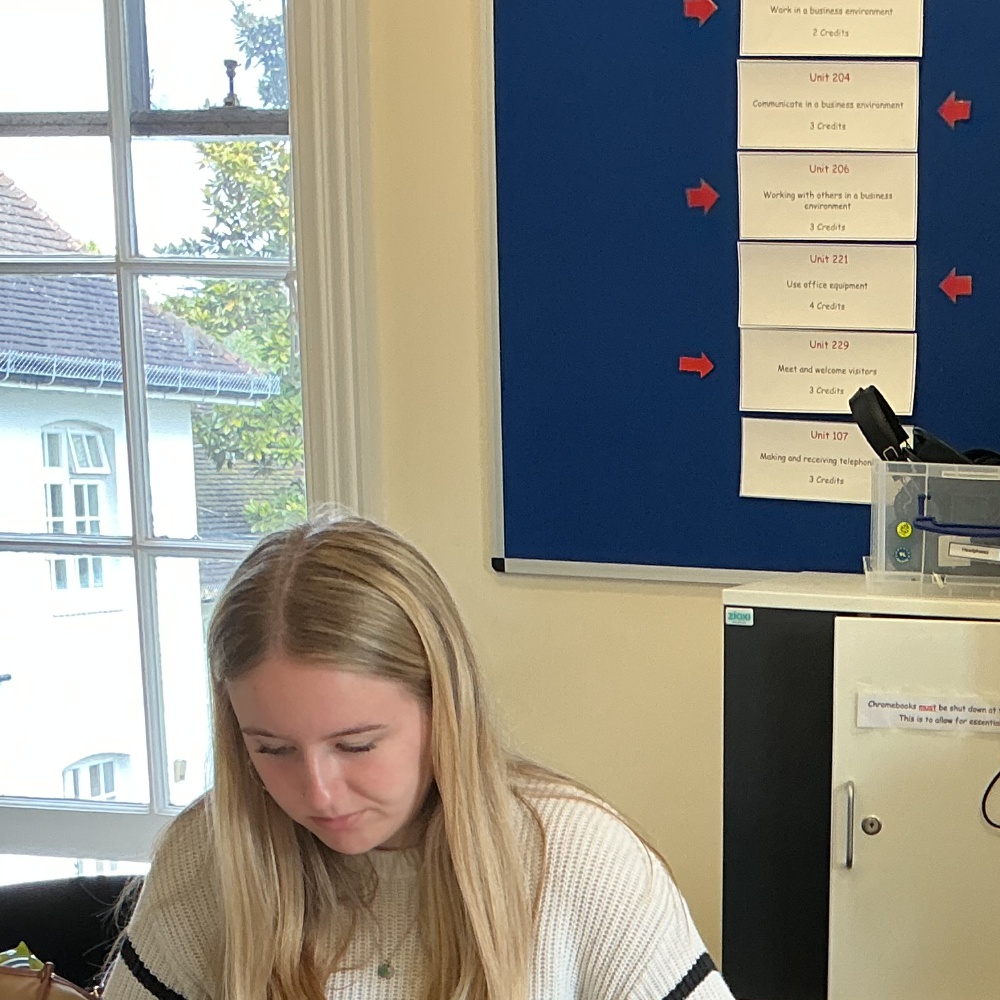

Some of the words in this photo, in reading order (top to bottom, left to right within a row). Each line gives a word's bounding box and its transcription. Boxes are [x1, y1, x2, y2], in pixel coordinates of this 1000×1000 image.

[770, 6, 792, 14] Work
[810, 7, 843, 15] business
[845, 8, 893, 16] environment
[820, 28, 849, 38] Credits
[809, 72, 830, 82] Unit
[832, 73, 850, 83] 204
[752, 100, 803, 109] Communicate
[805, 101, 812, 109] in
[821, 100, 854, 109] business
[856, 101, 904, 110] environment
[809, 122, 815, 131] 3
[817, 122, 846, 131] Credits
[809, 165, 830, 174] Unit
[831, 165, 850, 174] 206
[763, 191, 796, 201] Working
[797, 191, 815, 200] with
[816, 191, 842, 200] others
[844, 192, 852, 200] in
[860, 191, 893, 200] business
[804, 202, 852, 210] environment
[809, 223, 815, 231] 3
[817, 223, 846, 232] Credits
[809, 254, 830, 264] Unit
[832, 255, 848, 265] 221
[786, 280, 802, 289] Use
[803, 280, 828, 289] office
[829, 281, 868, 292] equipment
[809, 302, 815, 310] 4
[817, 302, 846, 311] Credits
[809, 340, 829, 349] Unit
[831, 340, 850, 350] 229
[777, 364, 797, 373] Meet
[799, 365, 813, 374] and
[814, 366, 847, 375] welcome
[848, 367, 878, 376] visitors
[809, 386, 815, 395] 3
[816, 386, 844, 395] Credits
[810, 430, 830, 440] Unit
[832, 431, 849, 441] 107
[759, 452, 786, 463] Making
[787, 454, 802, 462] and
[803, 455, 838, 466] receiving
[809, 476, 814, 484] 3
[816, 476, 844, 485] Credits
[867, 700, 917, 710] Chromebooks
[918, 704, 937, 712] must
[938, 704, 948, 712] be
[949, 705, 966, 713] shut
[967, 706, 987, 714] down
[988, 706, 996, 714] at
[899, 714, 915, 723] This
[916, 715, 923, 723] is
[925, 715, 933, 724] to
[934, 716, 953, 724] allow
[955, 716, 967, 725] for
